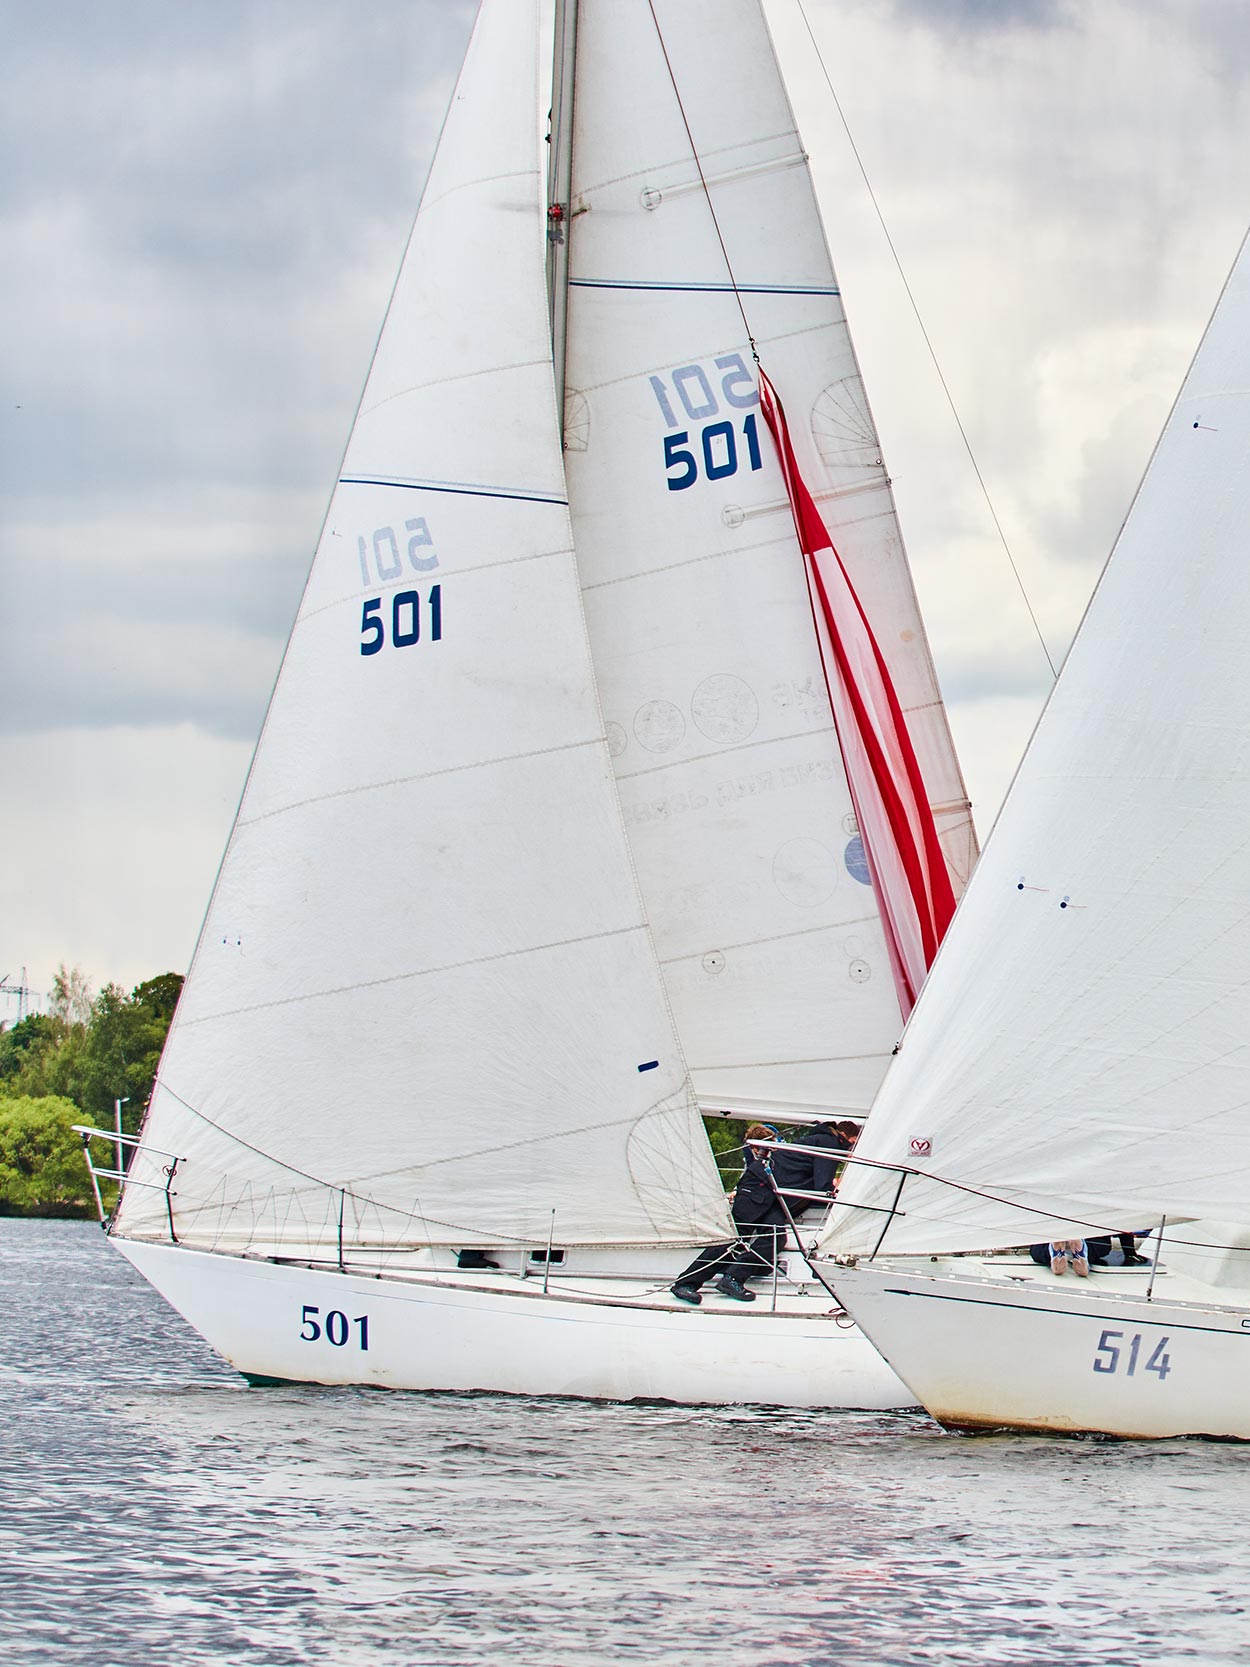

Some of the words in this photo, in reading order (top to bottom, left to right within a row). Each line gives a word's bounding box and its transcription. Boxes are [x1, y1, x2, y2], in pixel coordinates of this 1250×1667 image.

[664, 414, 763, 491] 501
[361, 584, 441, 656] 501
[300, 1305, 368, 1351] 501
[1093, 1330, 1171, 1380] 514
